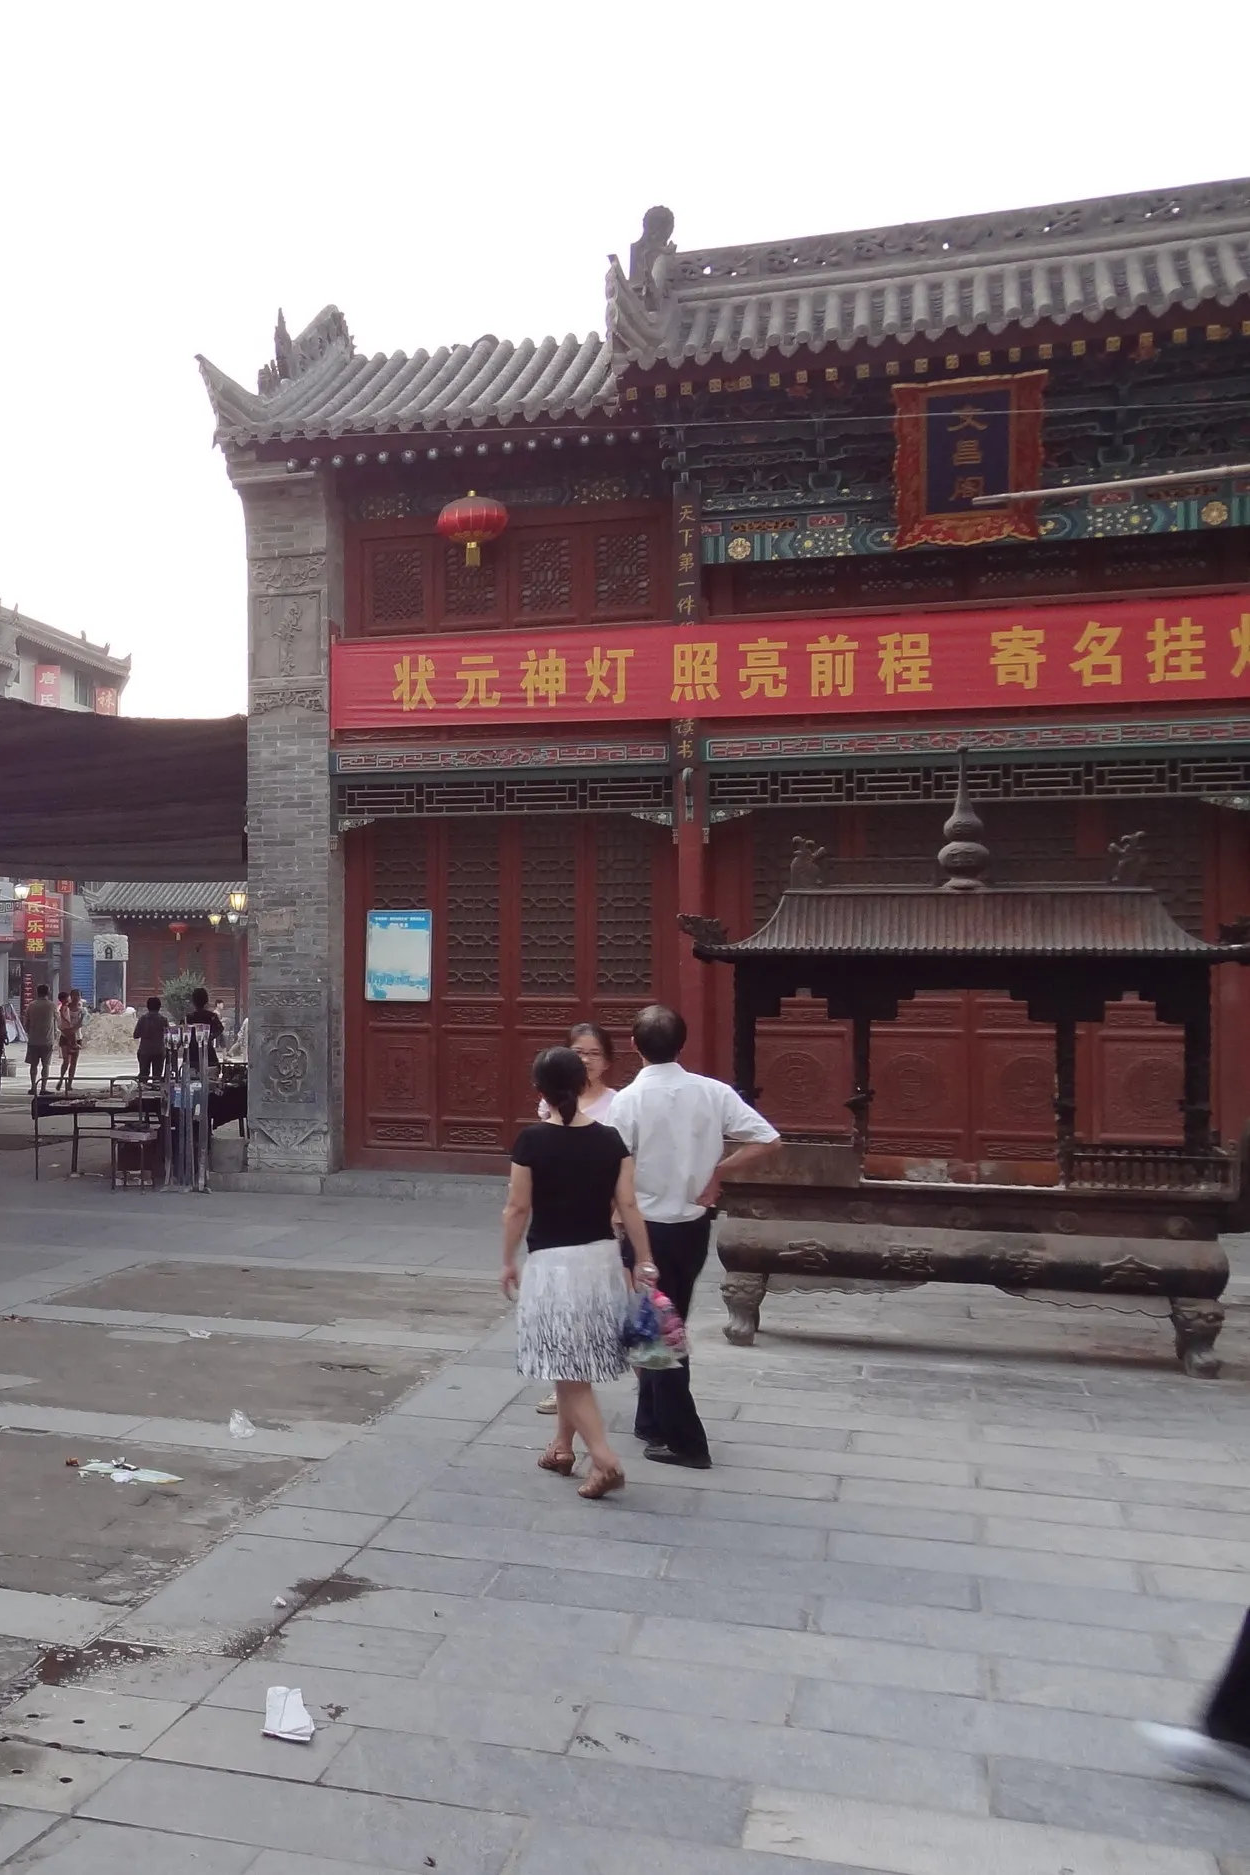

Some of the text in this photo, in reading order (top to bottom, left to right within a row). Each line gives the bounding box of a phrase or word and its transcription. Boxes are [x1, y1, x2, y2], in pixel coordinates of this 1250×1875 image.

[392, 646, 635, 711] 状元神灯
[670, 633, 934, 703] 照亮前程
